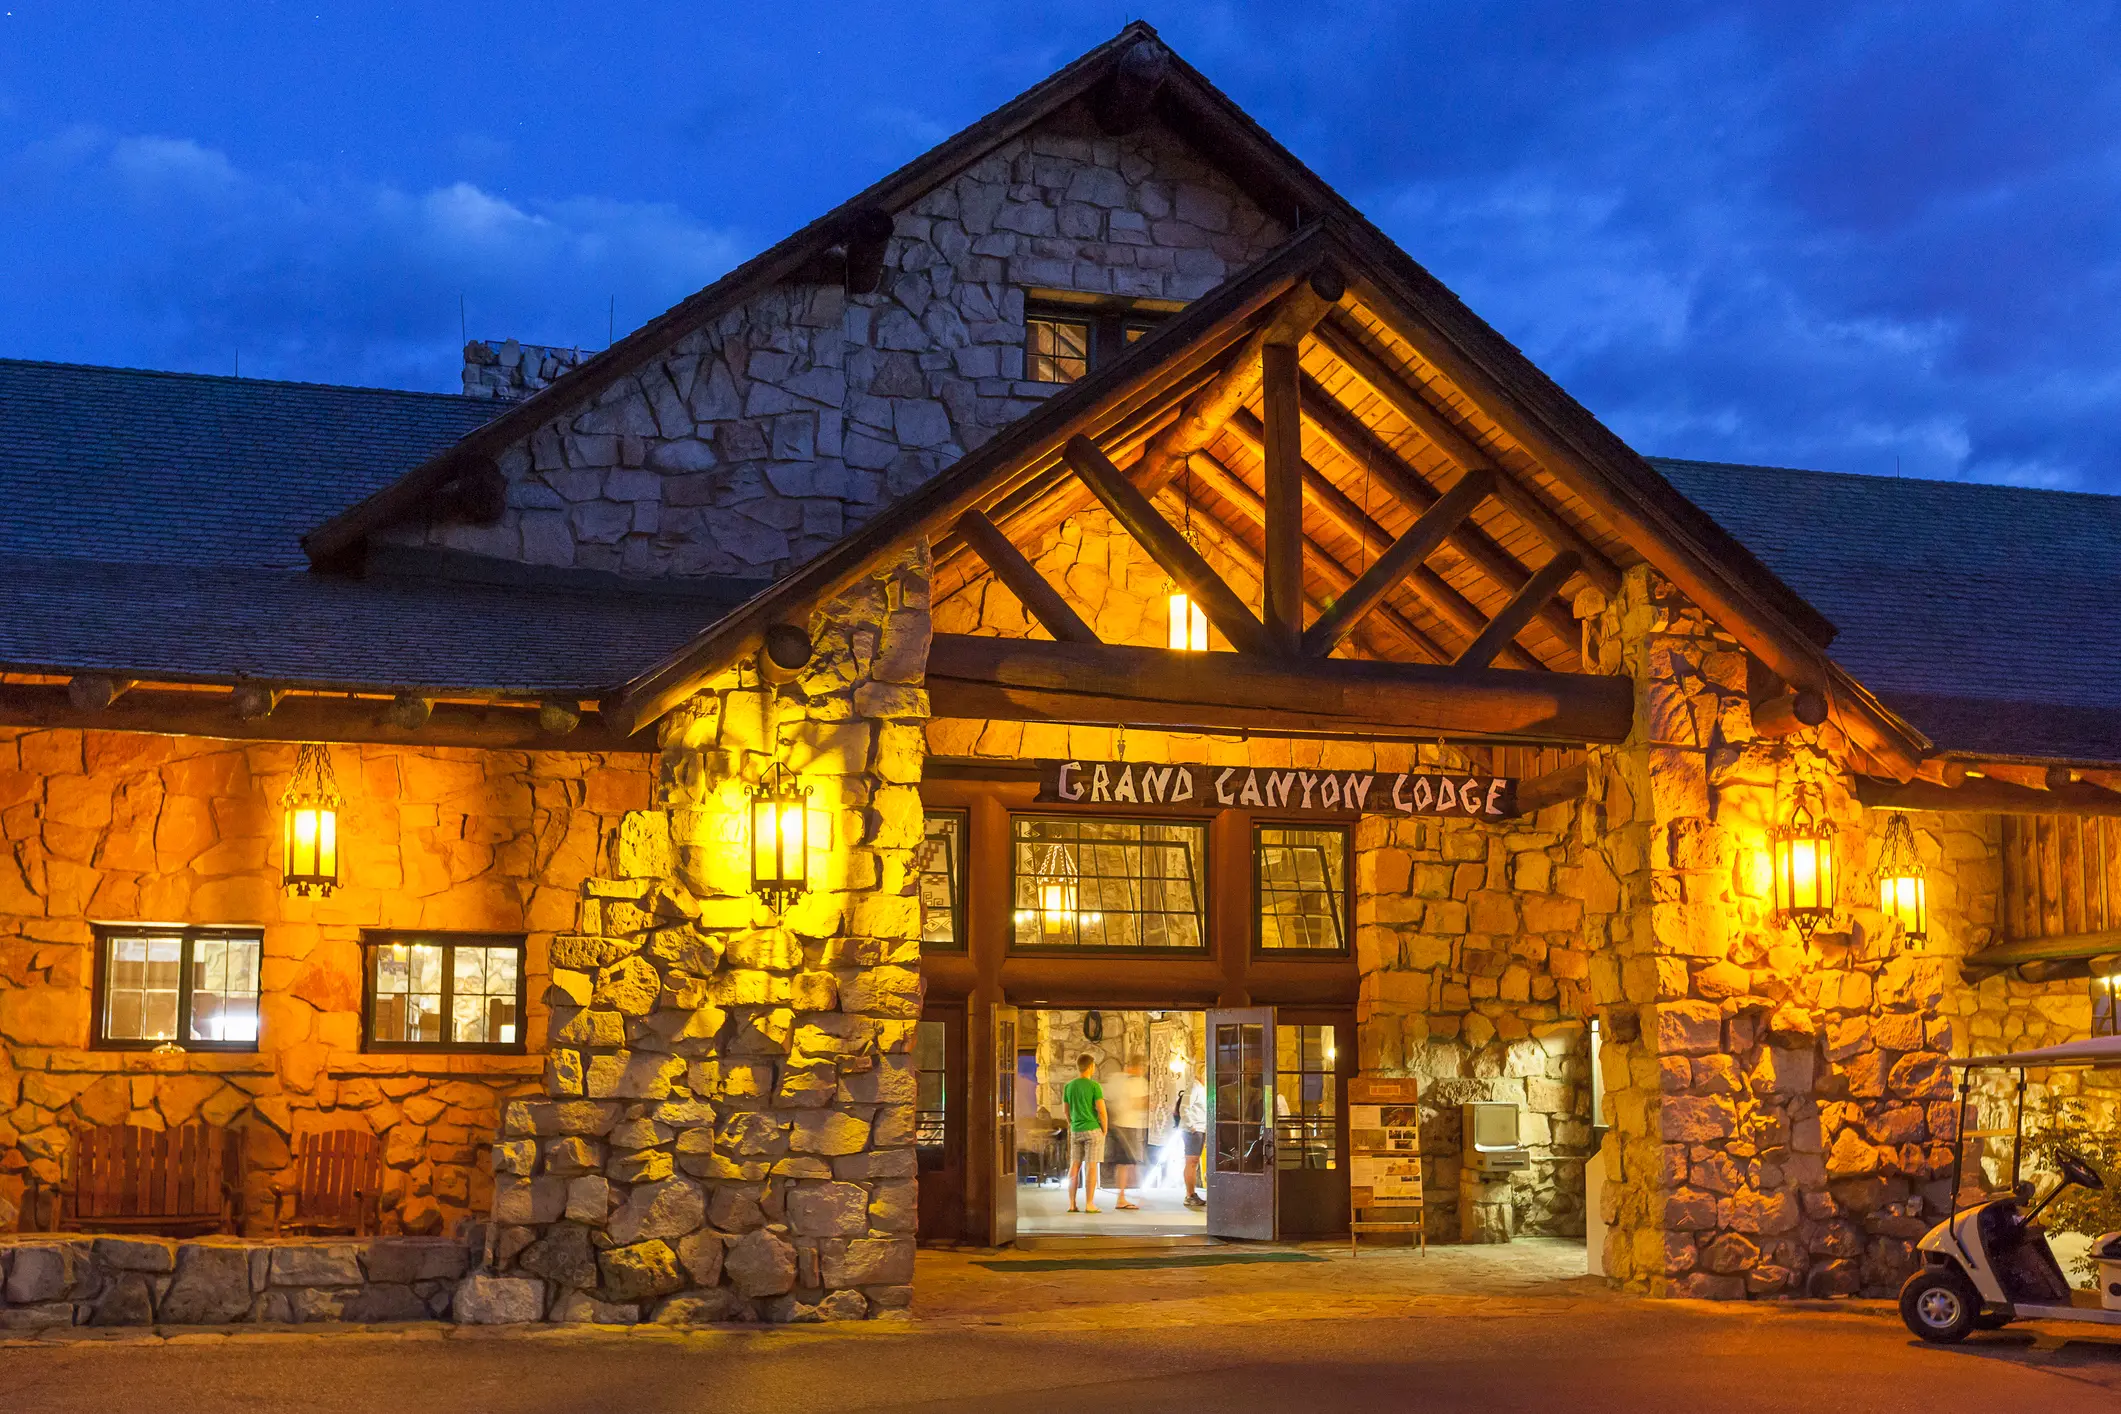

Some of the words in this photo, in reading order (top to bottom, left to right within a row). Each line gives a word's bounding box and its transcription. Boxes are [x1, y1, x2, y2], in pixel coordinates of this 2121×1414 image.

[1058, 761, 1193, 803] GRAND
[1214, 767, 1374, 810] CANYON
[1392, 773, 1504, 814] LODGE
